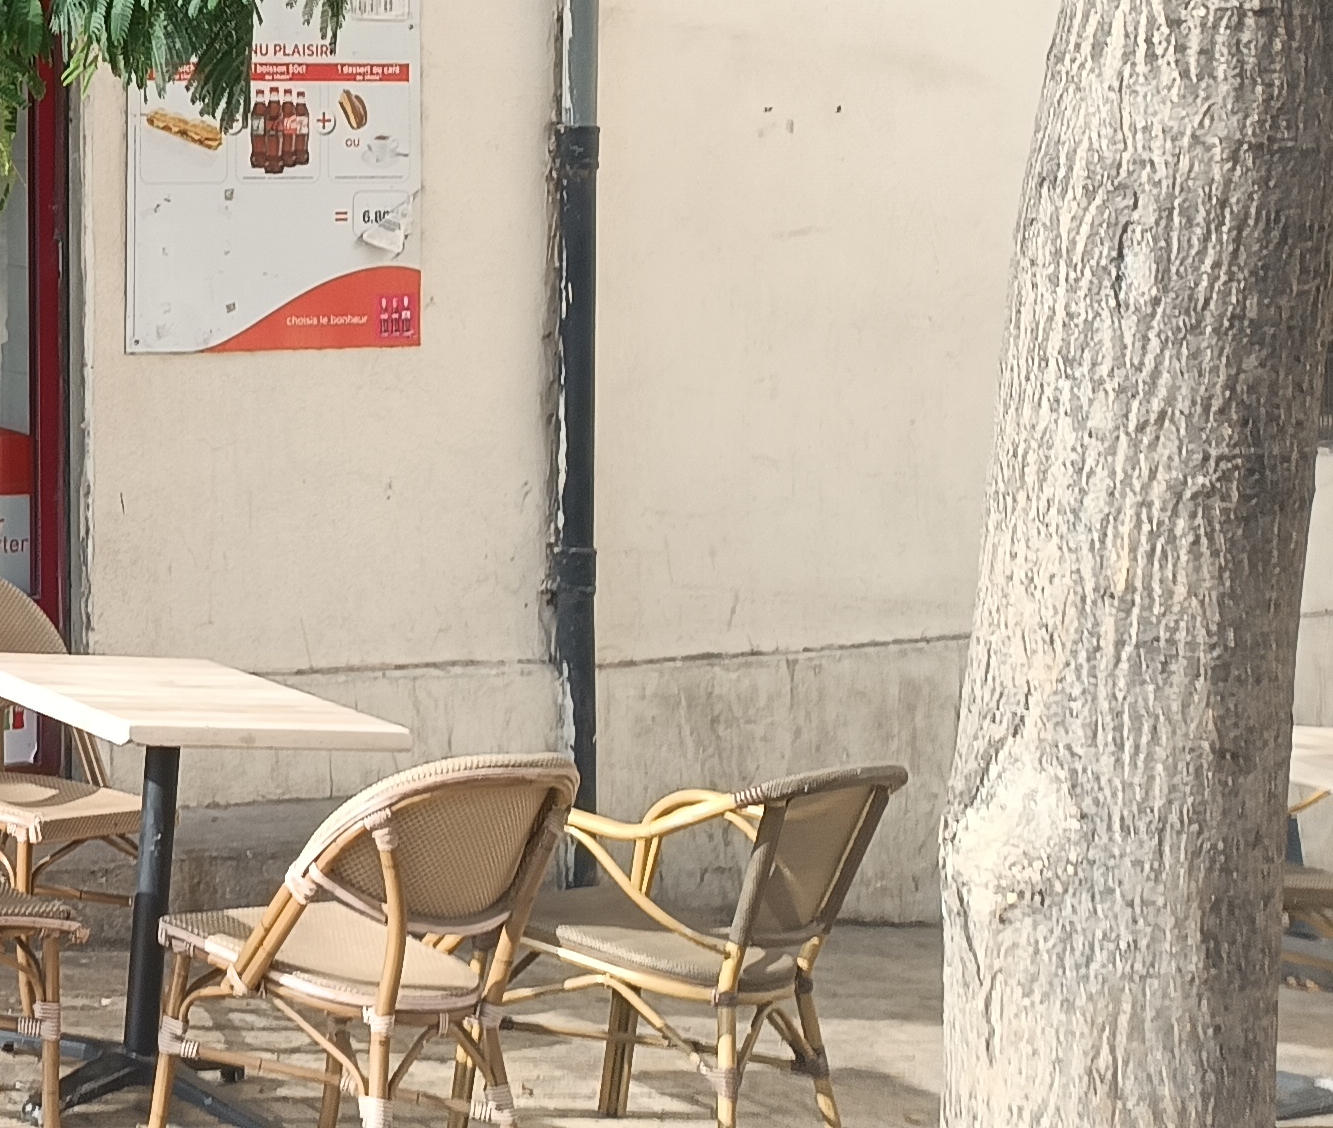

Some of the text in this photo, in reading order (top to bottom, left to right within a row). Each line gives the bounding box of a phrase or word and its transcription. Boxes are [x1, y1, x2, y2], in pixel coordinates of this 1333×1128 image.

[252, 43, 331, 57] NU PLAISIR
[345, 138, 360, 148] OU
